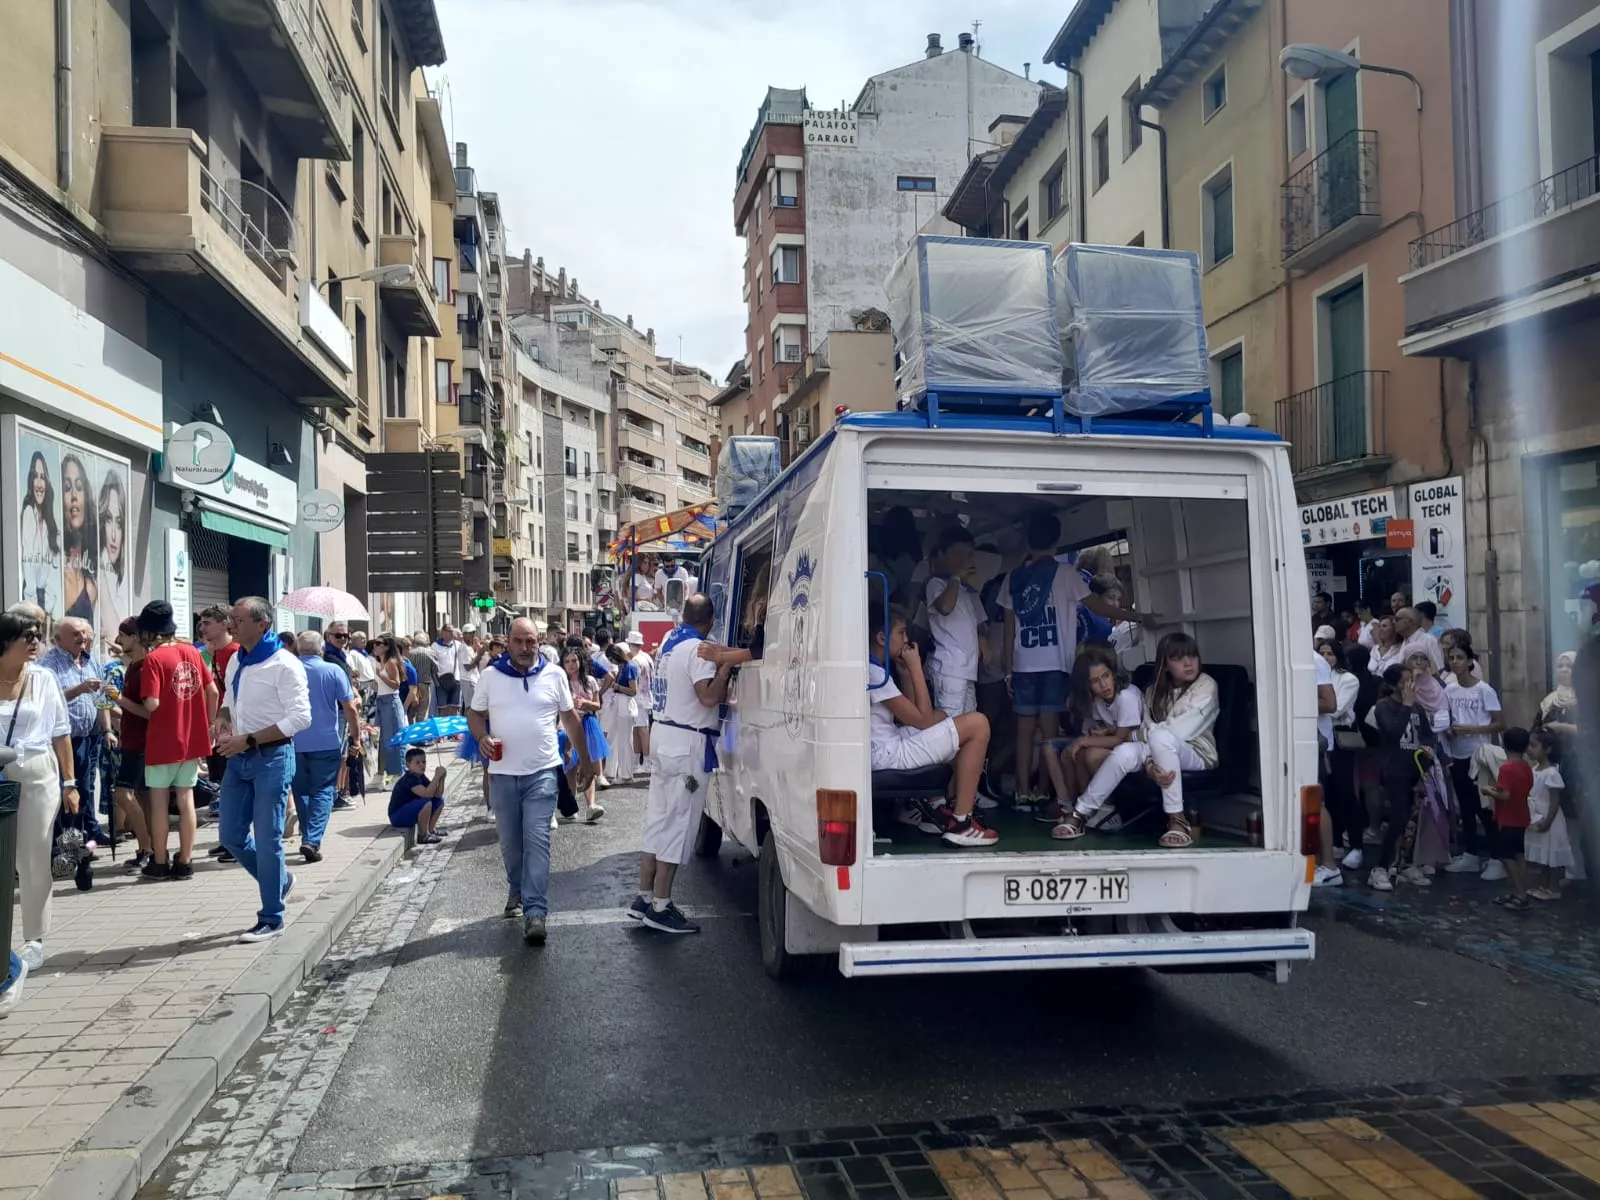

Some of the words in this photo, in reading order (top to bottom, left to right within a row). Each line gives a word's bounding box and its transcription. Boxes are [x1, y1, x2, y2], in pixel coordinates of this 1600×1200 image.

[809, 111, 853, 120] HOSTAL
[804, 120, 857, 130] PALAFOX
[808, 134, 854, 143] GARAGE
[1414, 484, 1458, 503] GLOBAL
[1302, 503, 1349, 525] GLOBAL
[1351, 495, 1388, 517] TECH
[1421, 503, 1451, 519] TECH
